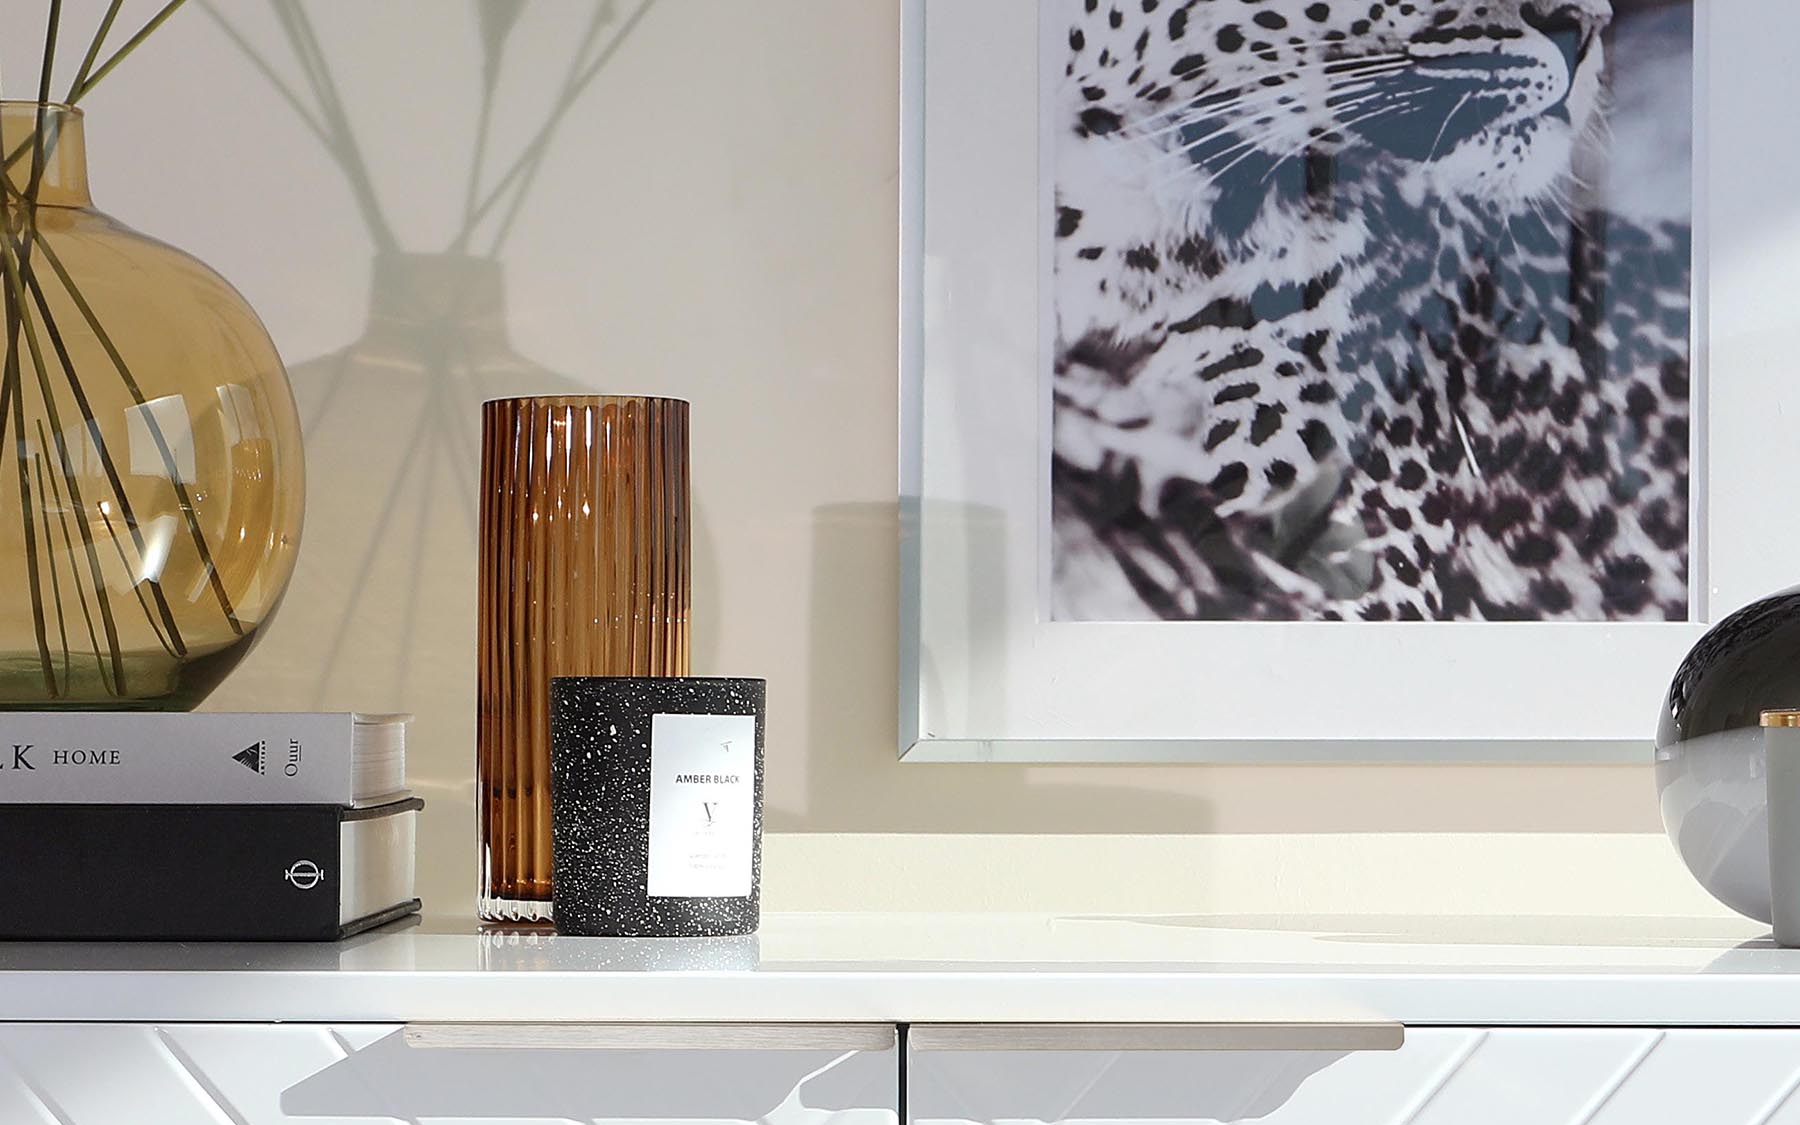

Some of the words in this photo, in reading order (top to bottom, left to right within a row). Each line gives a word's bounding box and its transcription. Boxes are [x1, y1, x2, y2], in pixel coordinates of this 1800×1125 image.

[52, 749, 120, 765] HOME
[284, 738, 299, 777] Ouur
[675, 774, 712, 784] AMBER
[713, 774, 740, 785] BLACK
